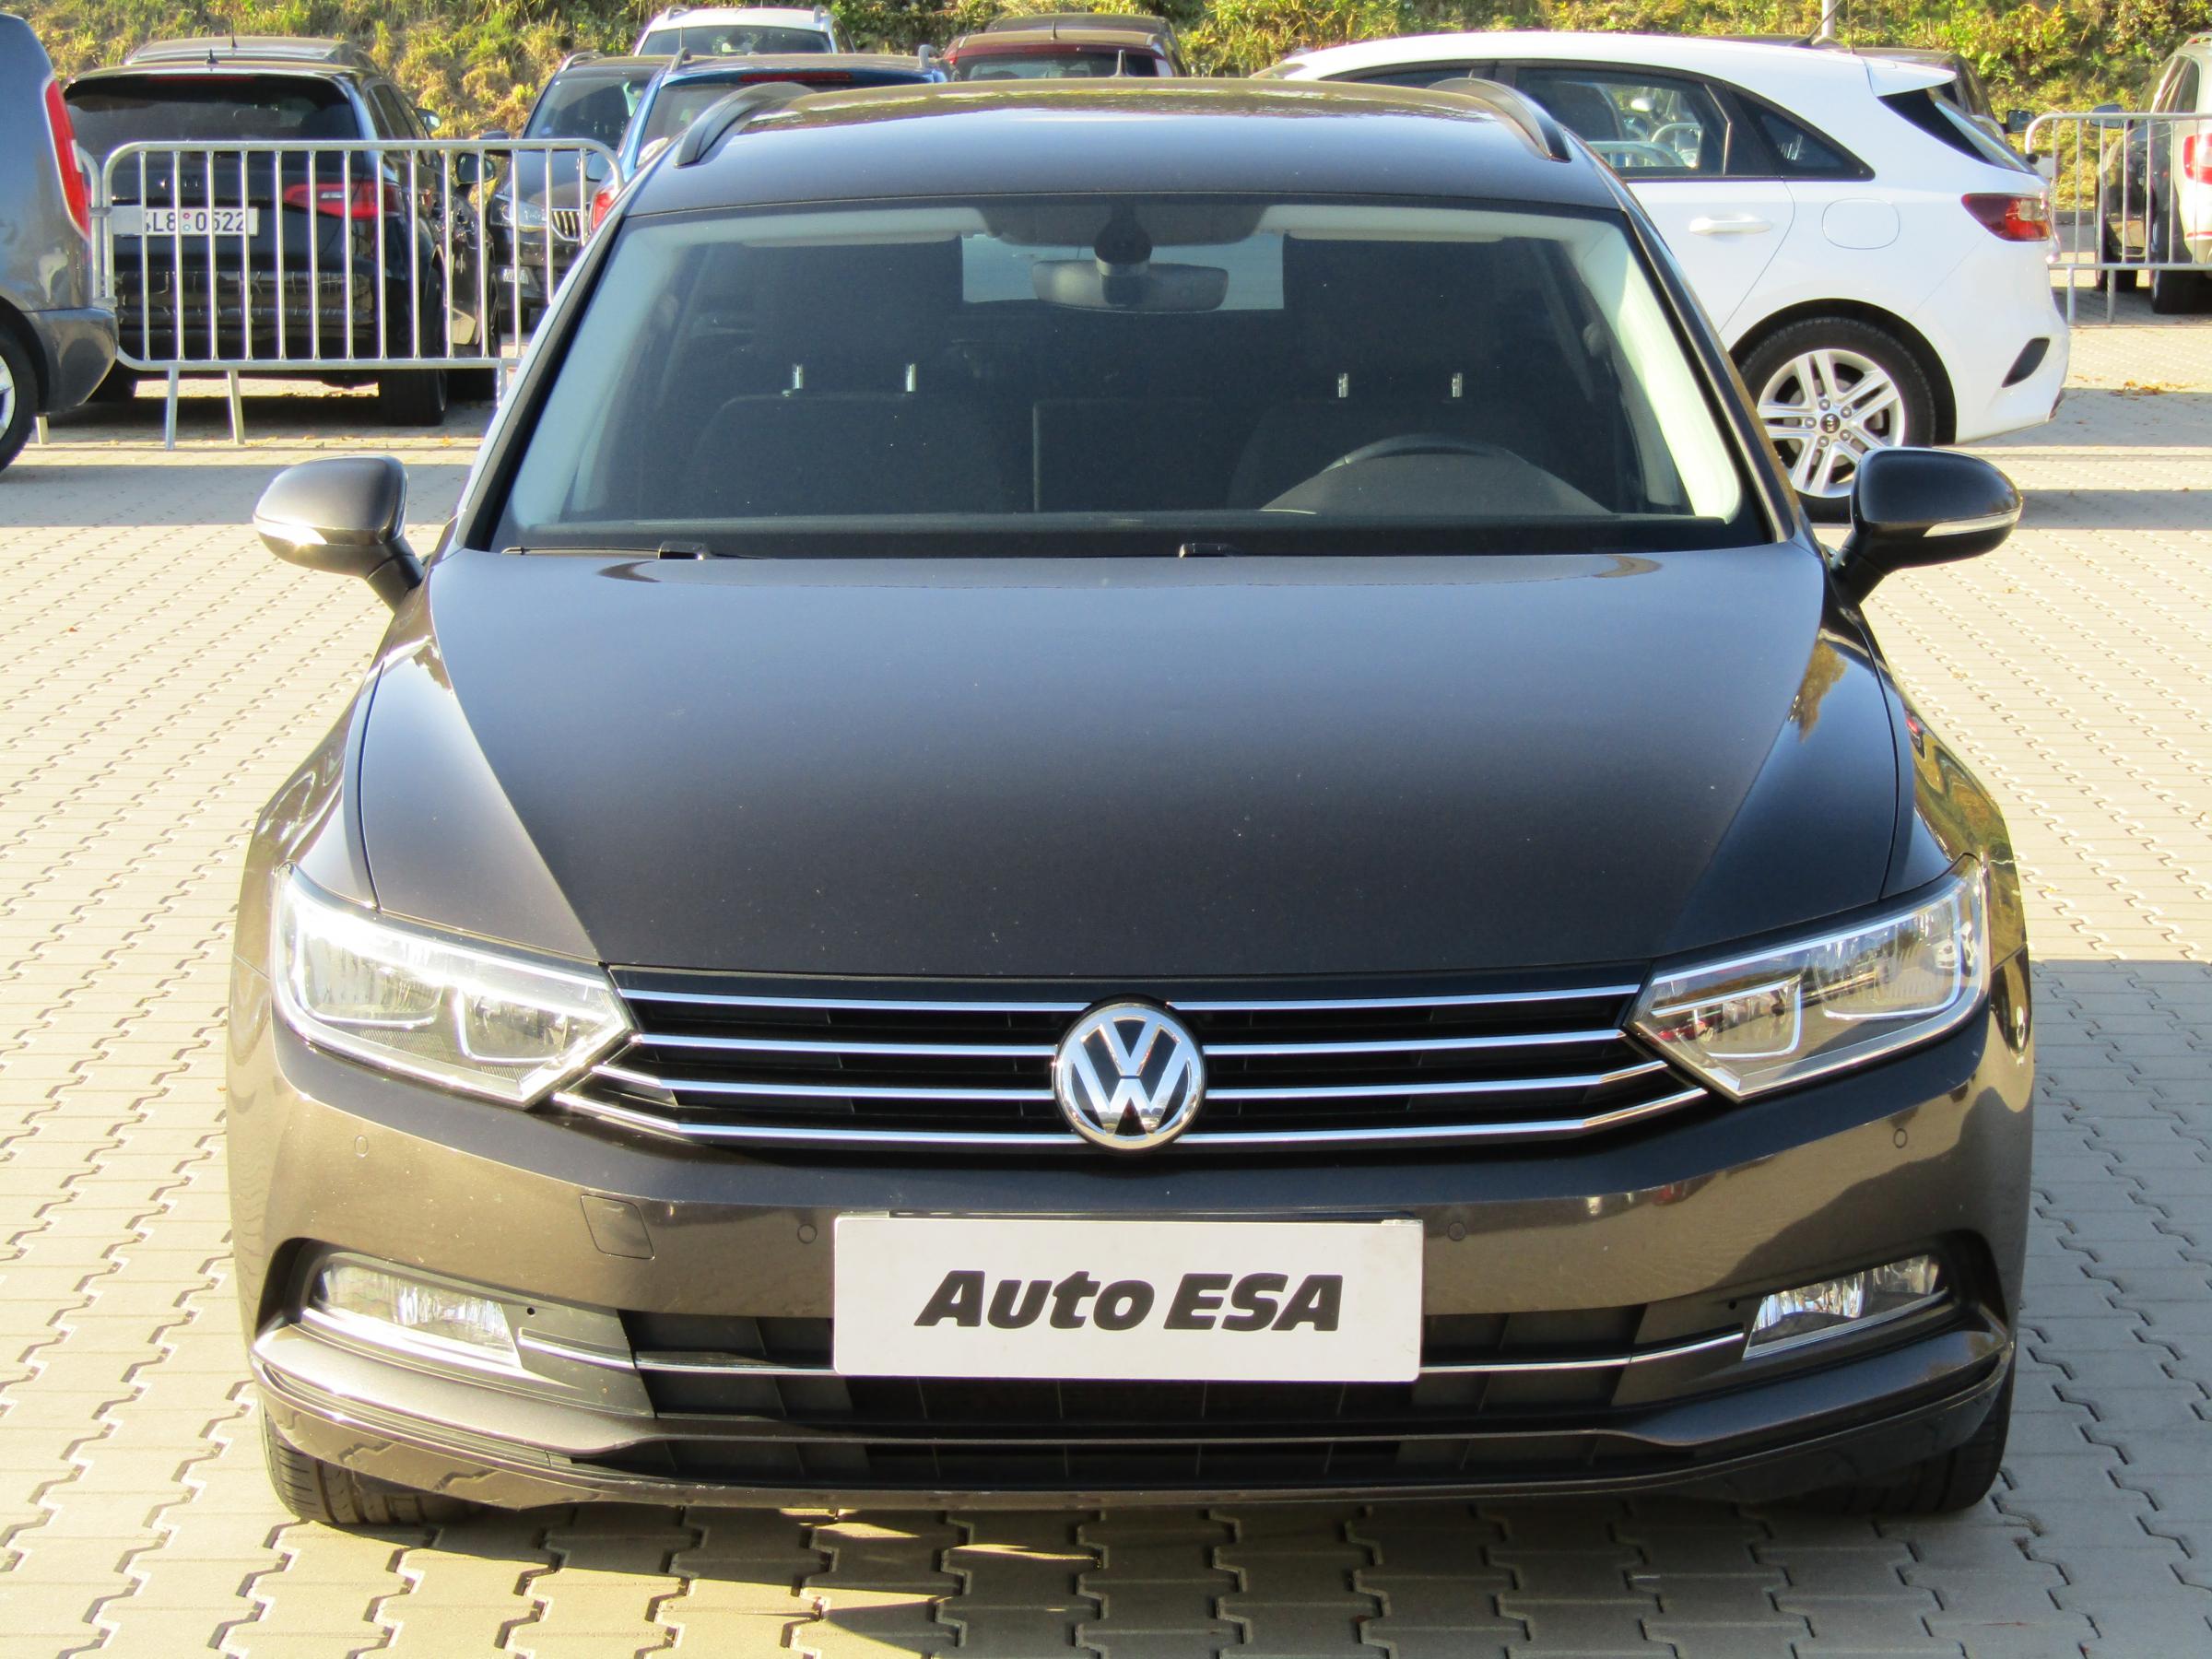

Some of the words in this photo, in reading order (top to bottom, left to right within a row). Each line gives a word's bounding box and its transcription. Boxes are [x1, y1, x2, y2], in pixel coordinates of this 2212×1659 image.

[195, 211, 244, 232] 0522
[913, 1270, 1155, 1331] Auto
[1163, 1273, 1344, 1332] ESA
